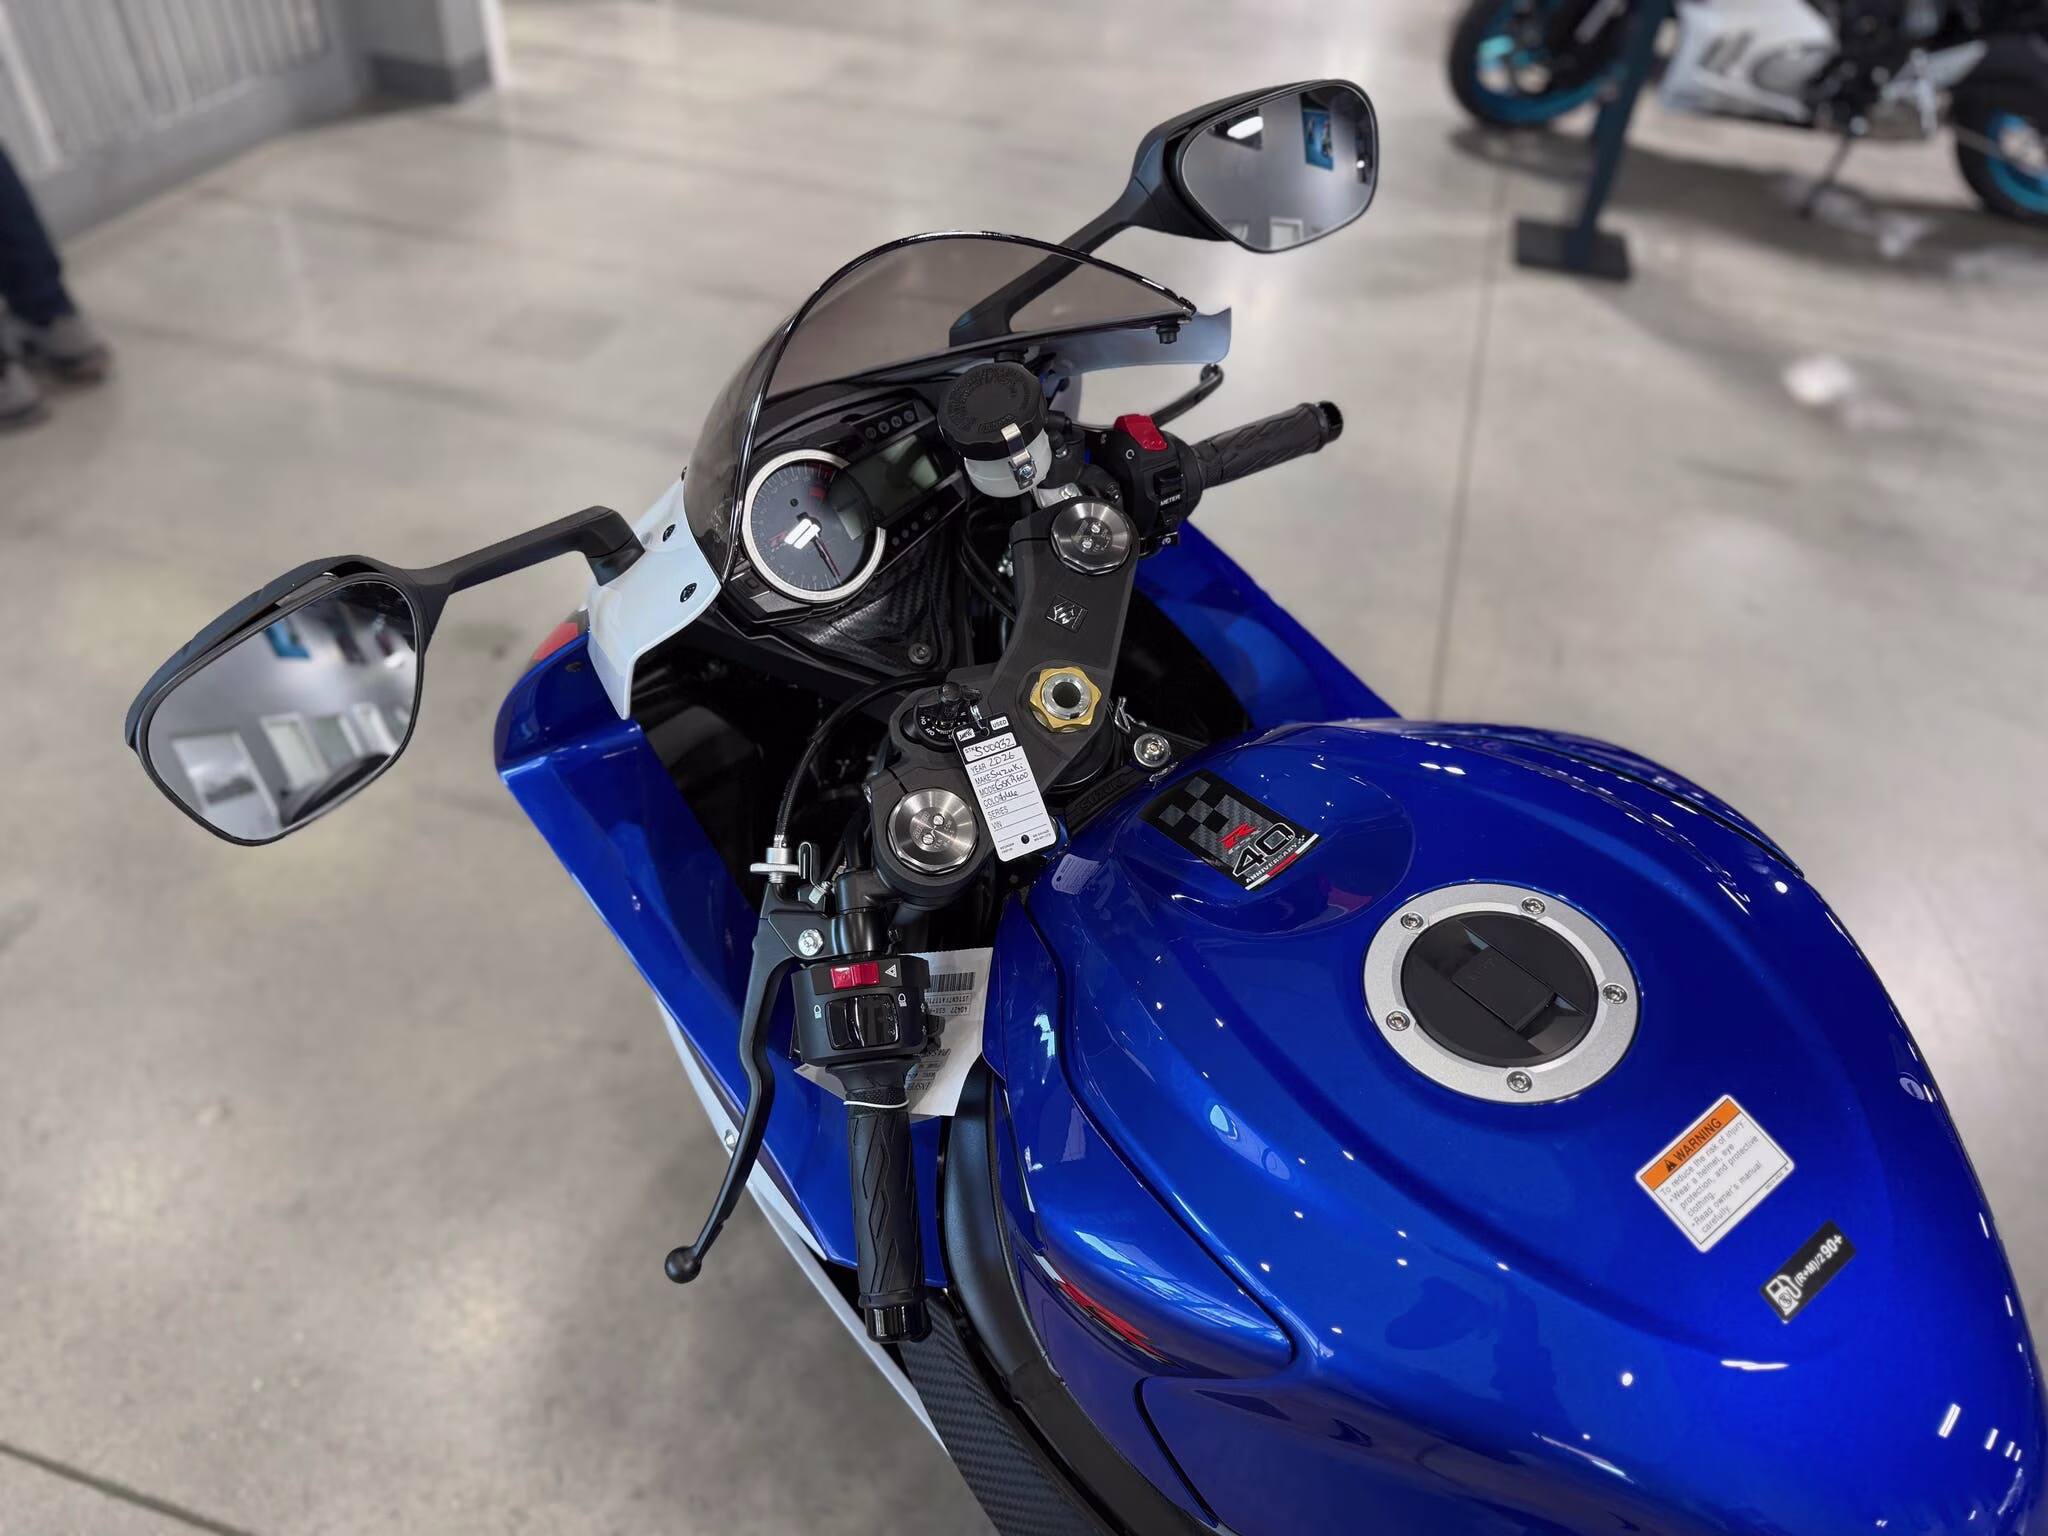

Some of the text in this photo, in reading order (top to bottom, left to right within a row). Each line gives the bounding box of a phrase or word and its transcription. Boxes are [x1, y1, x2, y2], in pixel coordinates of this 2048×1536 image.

[992, 719, 1007, 729] USED
[971, 752, 1015, 773] YEAR 2026
[975, 774, 991, 785] MAKE
[987, 805, 1009, 819] SERIES
[1246, 843, 1297, 884] ANNIVERSARY
[1660, 1120, 1745, 1196] To reduce the risk of injury
[1673, 1118, 1722, 1162] WARNING
[1679, 1135, 1759, 1210] protection, and protective
[1697, 1155, 1723, 1179] helmet,
[1722, 1143, 1735, 1157] eye
[1713, 1185, 1740, 1208] owner's
[1738, 1160, 1763, 1185] manual
[1687, 1191, 1716, 1217] clothing.
[1794, 1234, 1843, 1287] (R+M)/2 90+
